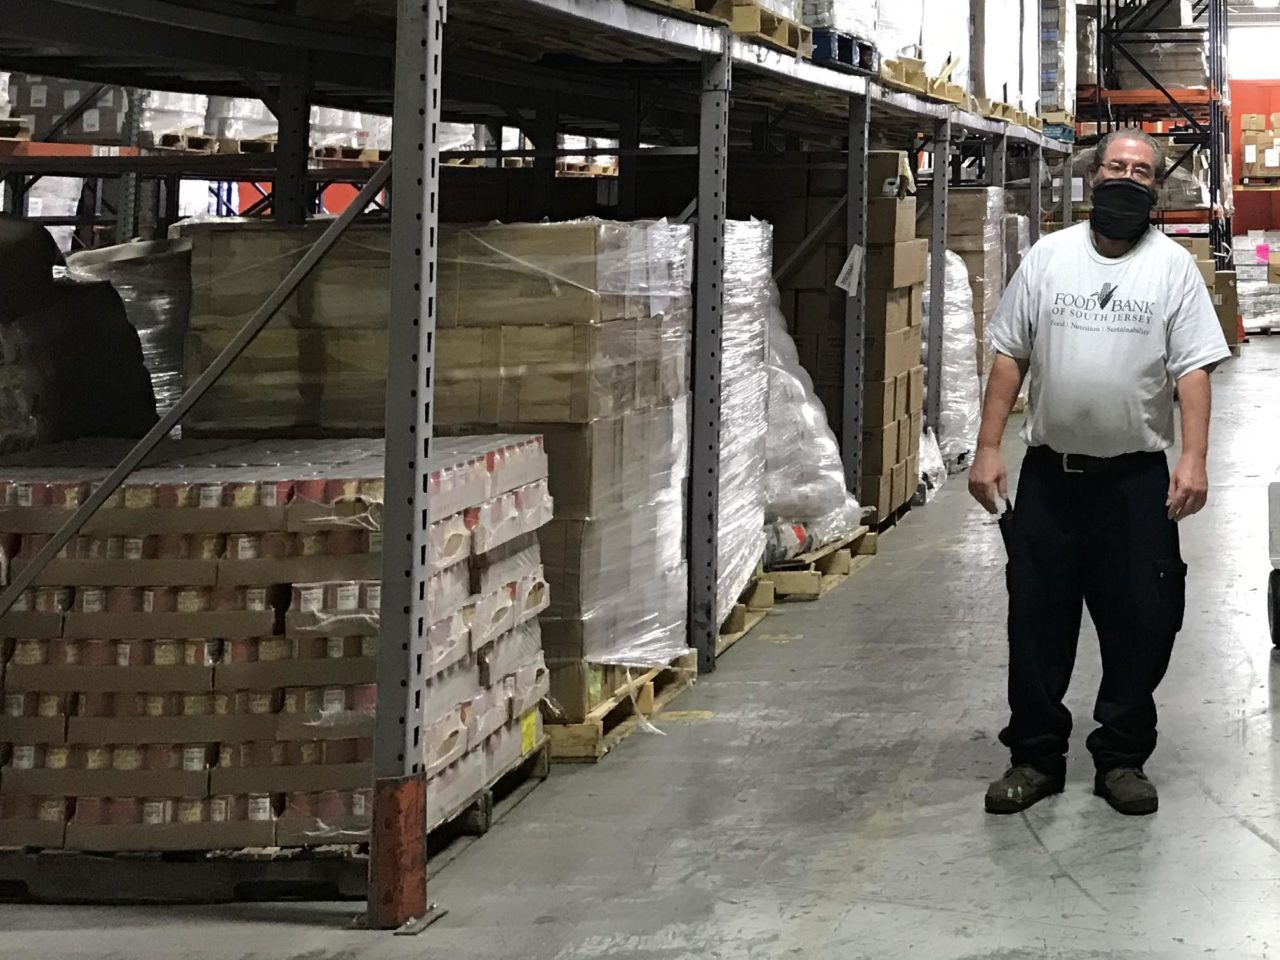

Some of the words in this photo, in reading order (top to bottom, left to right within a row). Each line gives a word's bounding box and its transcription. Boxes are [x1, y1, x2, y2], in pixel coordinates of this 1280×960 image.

[1054, 292, 1097, 311] FOOD
[1111, 299, 1155, 316] BANK
[1051, 306, 1066, 316] OF
[1069, 309, 1108, 322] SOUTH
[1112, 314, 1152, 325] JERSEY
[1050, 319, 1066, 328] Food
[1071, 321, 1100, 333] Nutrition
[1106, 326, 1150, 336] Sustainability
